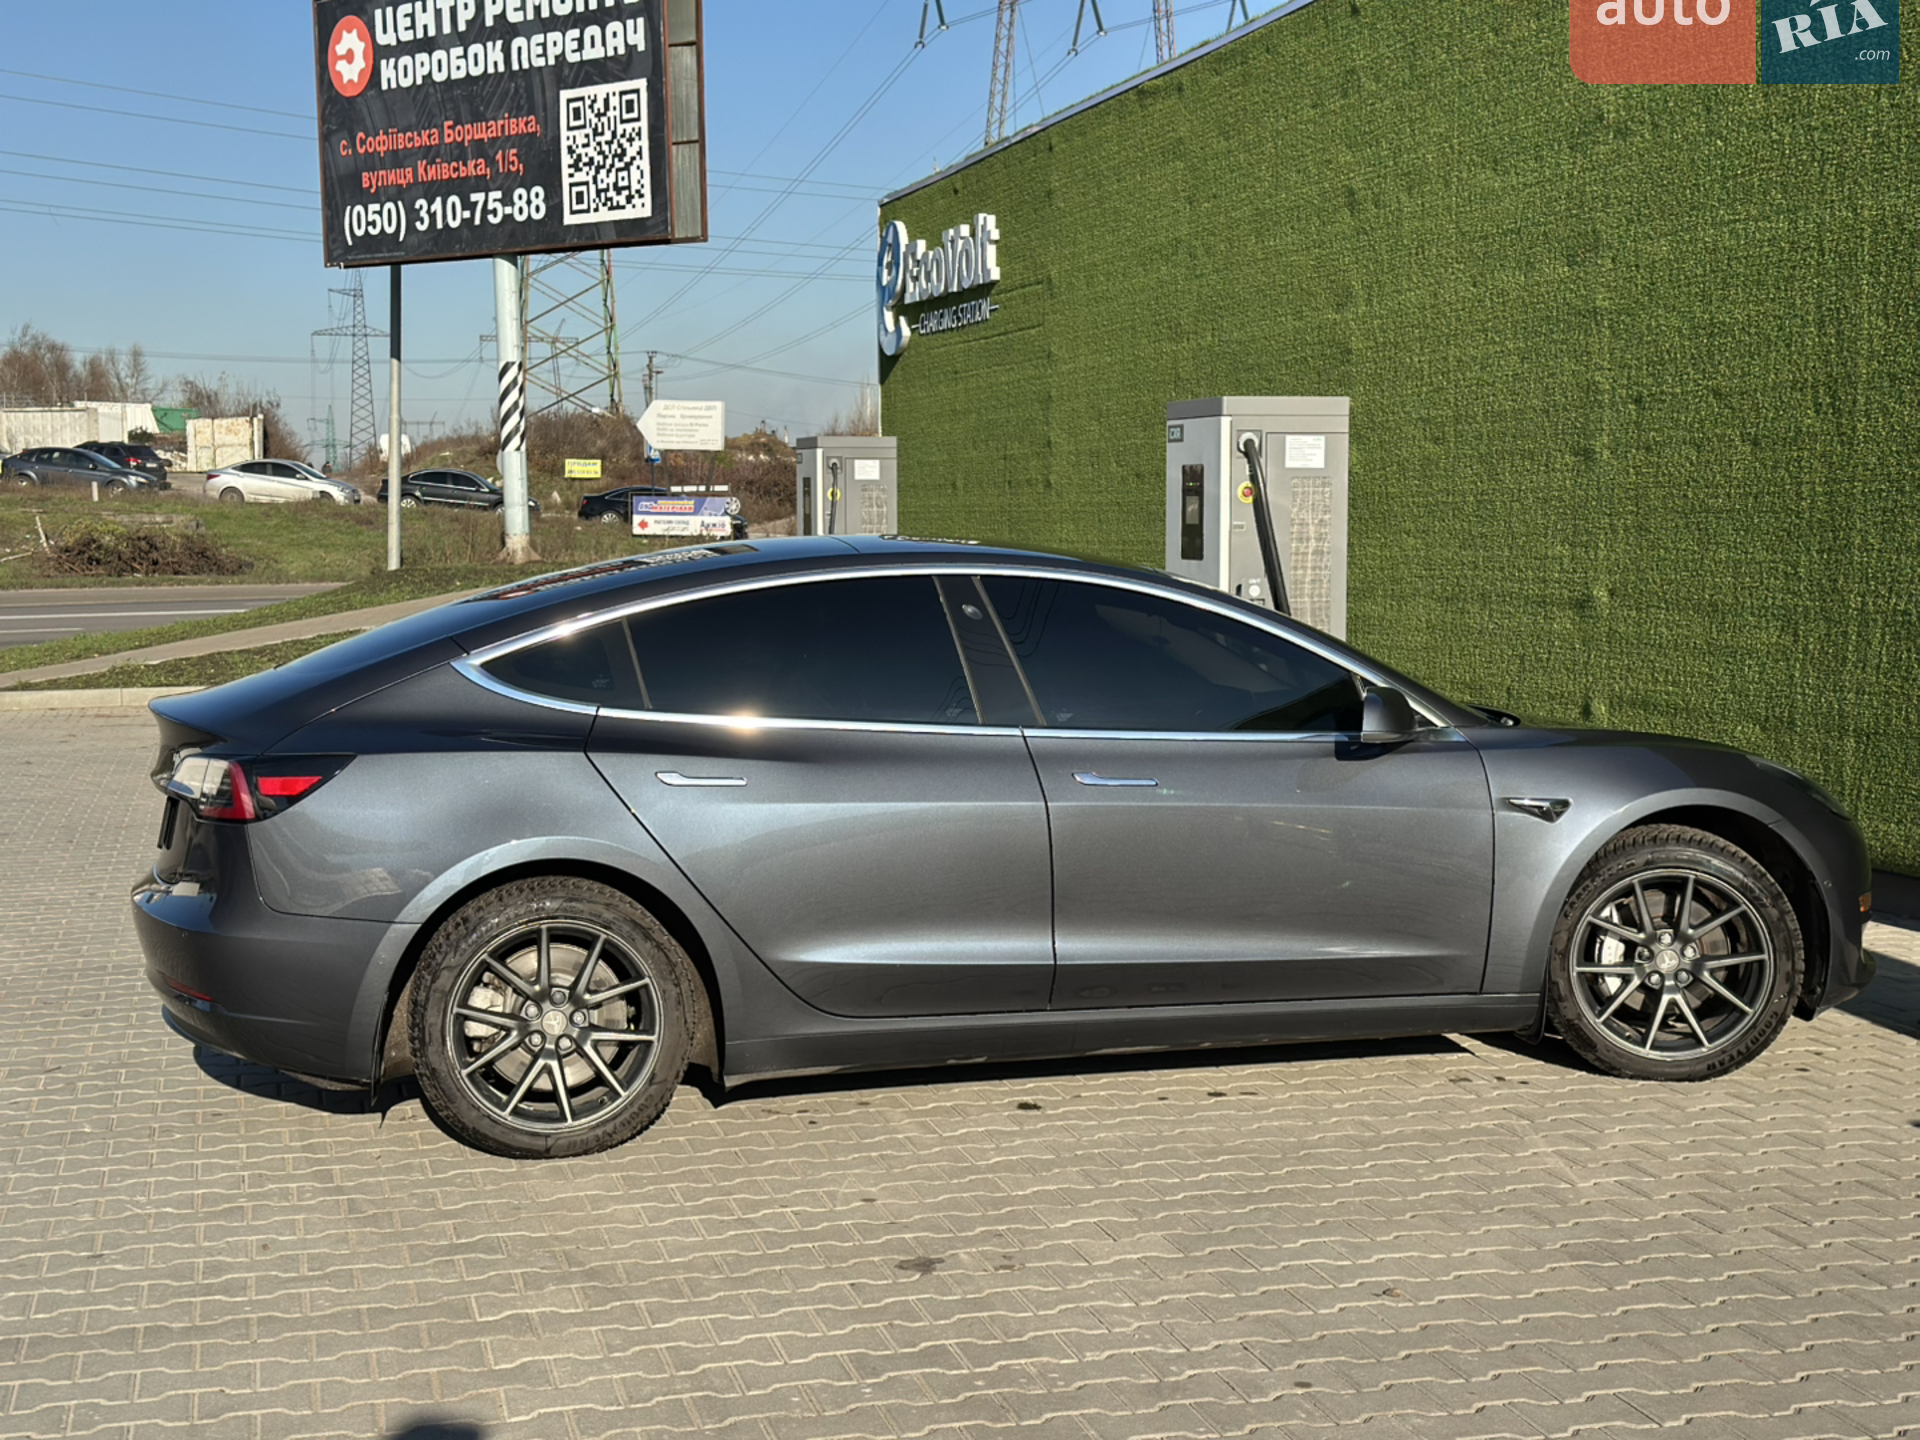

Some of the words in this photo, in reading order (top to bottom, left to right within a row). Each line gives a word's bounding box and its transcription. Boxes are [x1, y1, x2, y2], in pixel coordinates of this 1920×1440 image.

[374, 0, 476, 46] ЦЕНТР
[380, 40, 505, 91] КОРОБОК
[511, 17, 646, 71] ПЕРЕДАЧ
[340, 139, 352, 157] с.
[356, 127, 440, 157] Софіївська
[443, 113, 541, 146] Борщагівка,
[362, 167, 413, 194] вулиця
[417, 157, 491, 180] Київська,
[495, 148, 524, 176] 1/5,
[344, 200, 407, 246] (050)
[414, 185, 546, 231] 310-75-88
[903, 213, 1001, 304] EcoVolt
[919, 305, 957, 334] CHARGING
[957, 297, 990, 327] STATION
